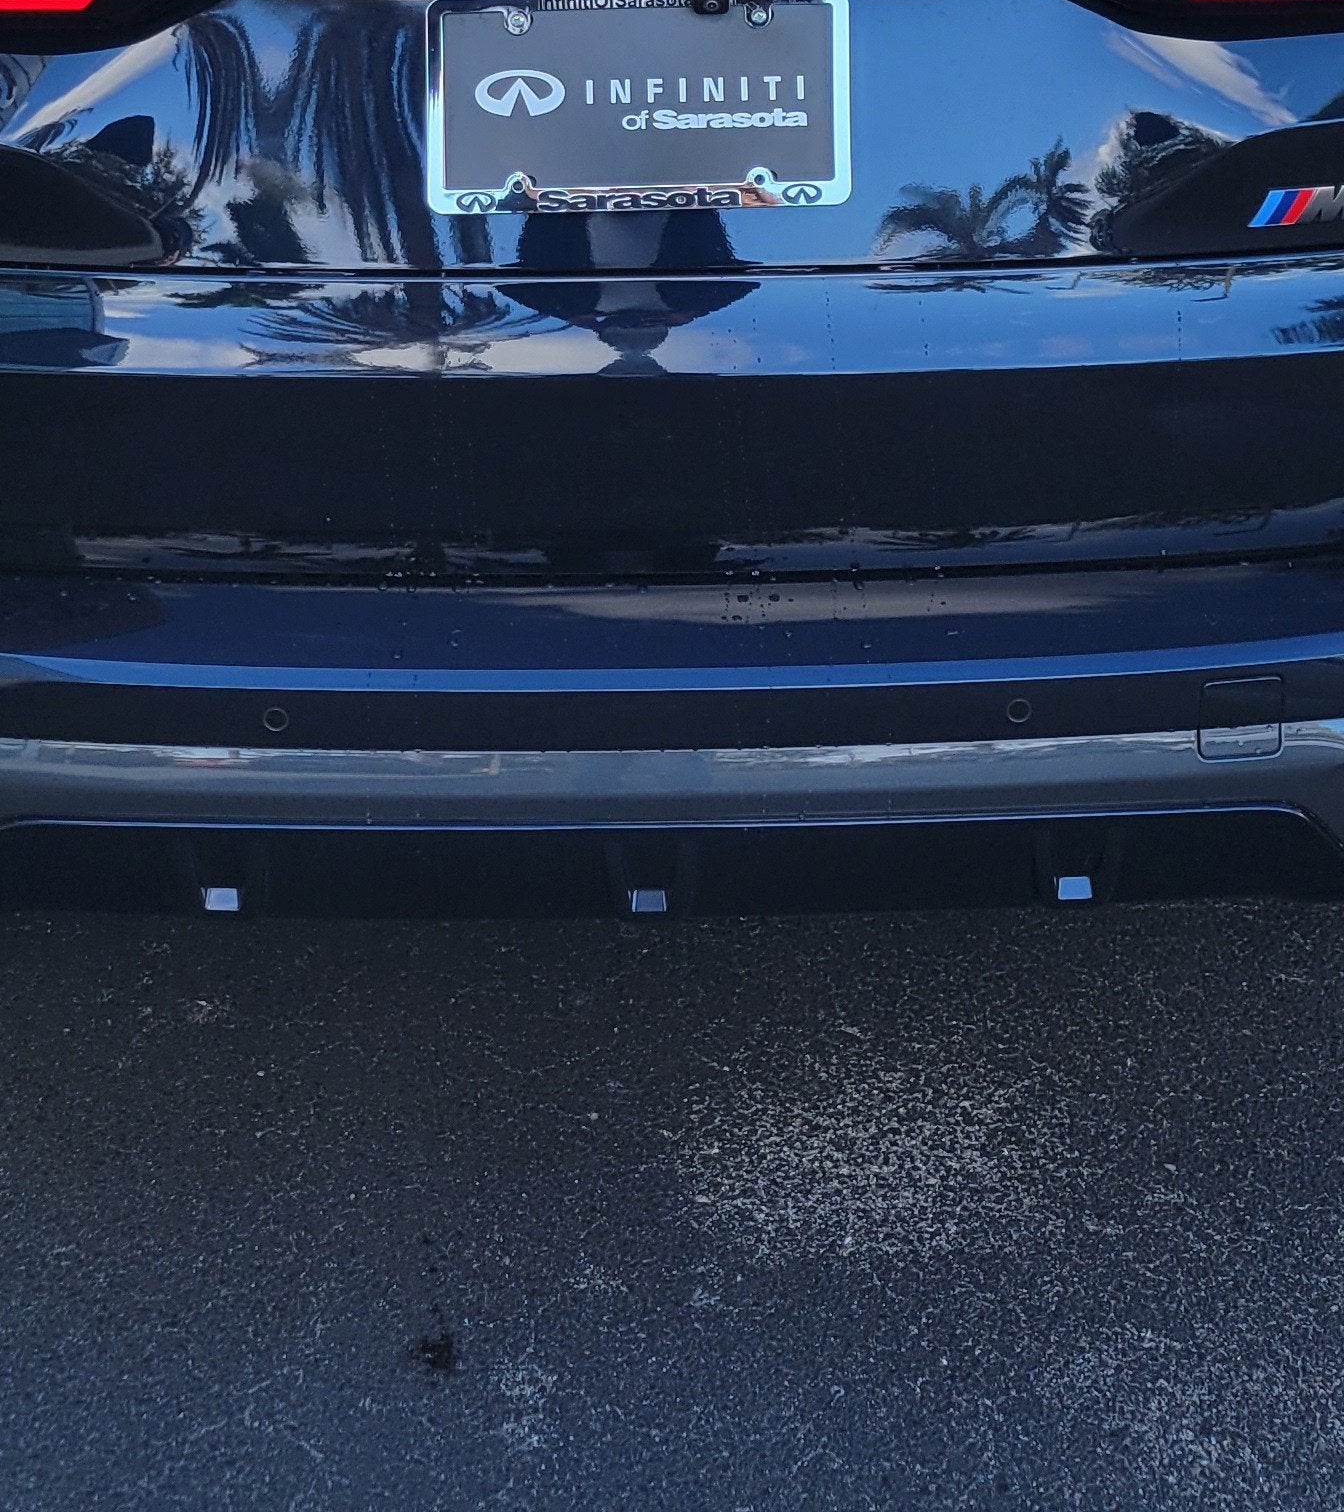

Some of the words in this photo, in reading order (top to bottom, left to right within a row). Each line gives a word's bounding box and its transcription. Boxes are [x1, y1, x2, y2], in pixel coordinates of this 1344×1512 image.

[585, 75, 805, 105] INFINITI
[621, 109, 650, 130] of
[652, 108, 808, 130] Sarasota
[537, 187, 742, 212] Sarasota
